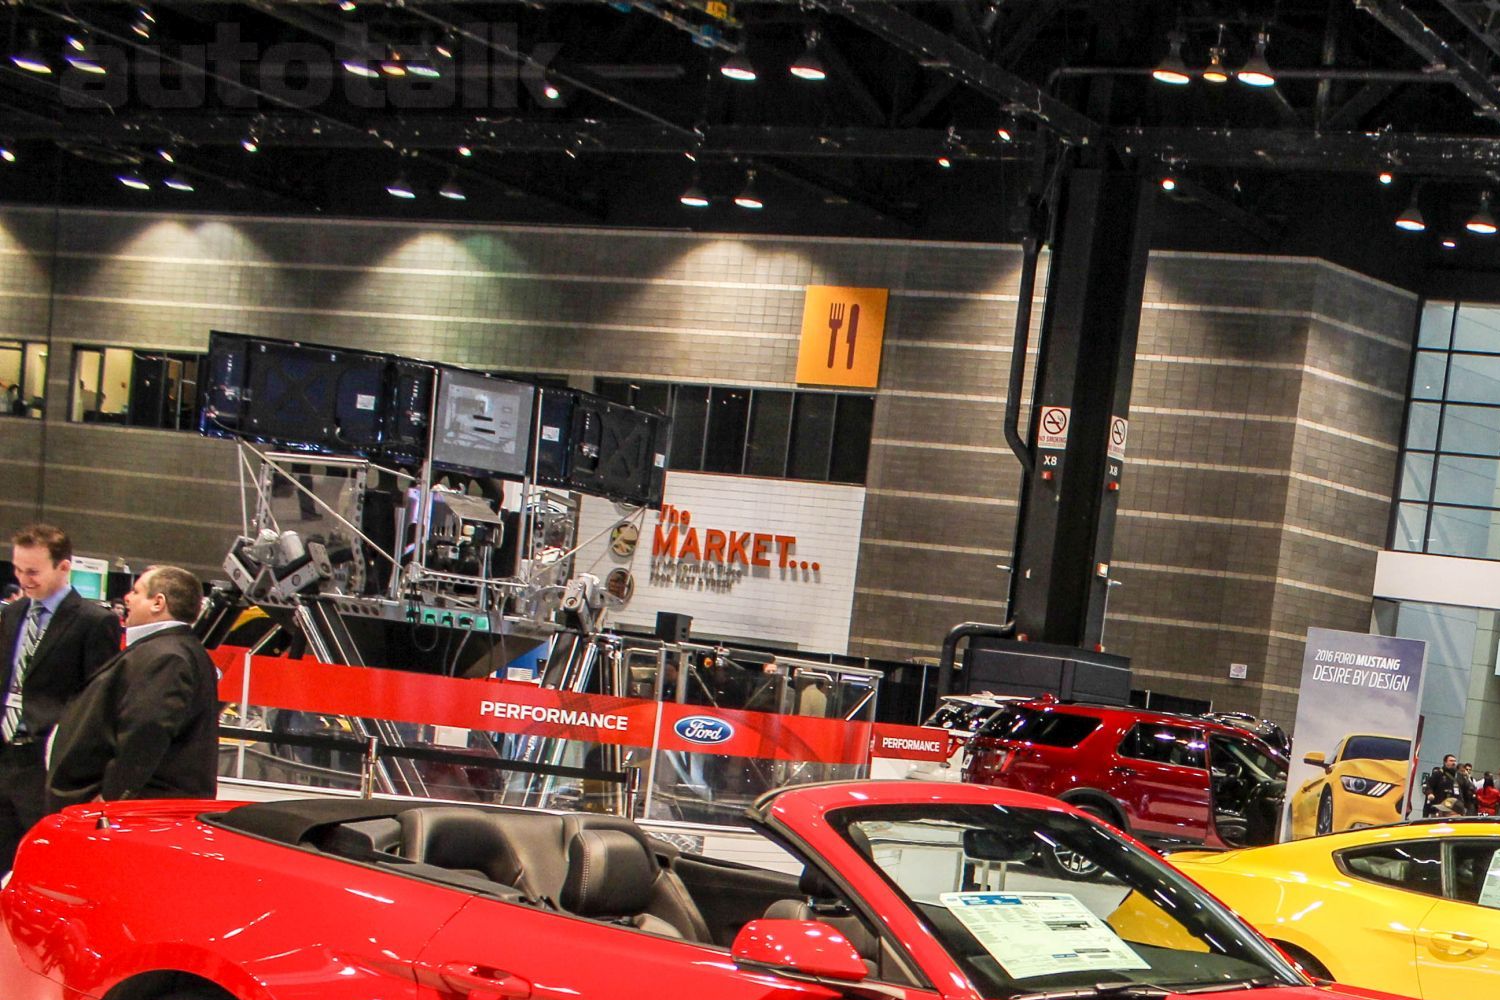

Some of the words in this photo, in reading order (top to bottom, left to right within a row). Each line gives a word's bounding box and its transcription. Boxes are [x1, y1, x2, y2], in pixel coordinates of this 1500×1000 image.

[1044, 455, 1057, 465] X8
[1109, 465, 1118, 475] X8
[659, 504, 691, 526] The
[1315, 649, 1333, 662] 2016
[1334, 651, 1356, 664] FORD
[1356, 654, 1400, 670] MUSTANG
[1313, 664, 1352, 684] DESIRE
[1352, 669, 1369, 686] BY
[1368, 672, 1410, 692] DESIGN
[480, 700, 628, 731] PERFORMANCE
[684, 719, 722, 741] Ford
[882, 737, 940, 752] PERFORMANCE
